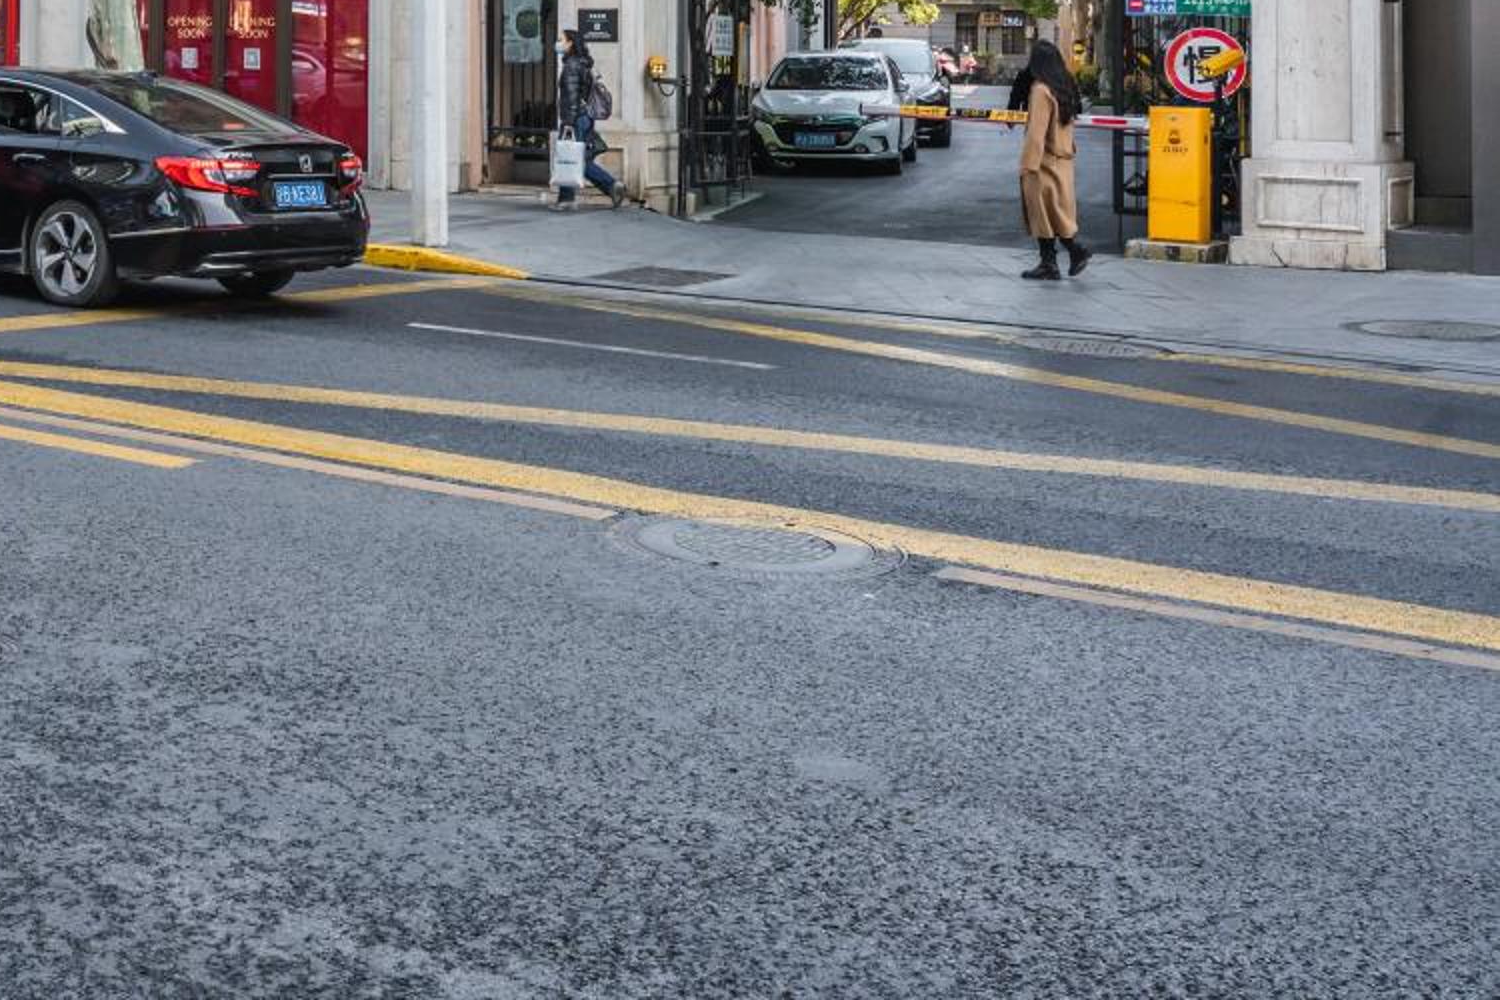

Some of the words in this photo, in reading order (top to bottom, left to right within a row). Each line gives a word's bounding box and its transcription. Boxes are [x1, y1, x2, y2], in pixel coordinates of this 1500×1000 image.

[167, 16, 213, 27] OPENING
[178, 27, 205, 39] SOON
[239, 29, 268, 39] SOON
